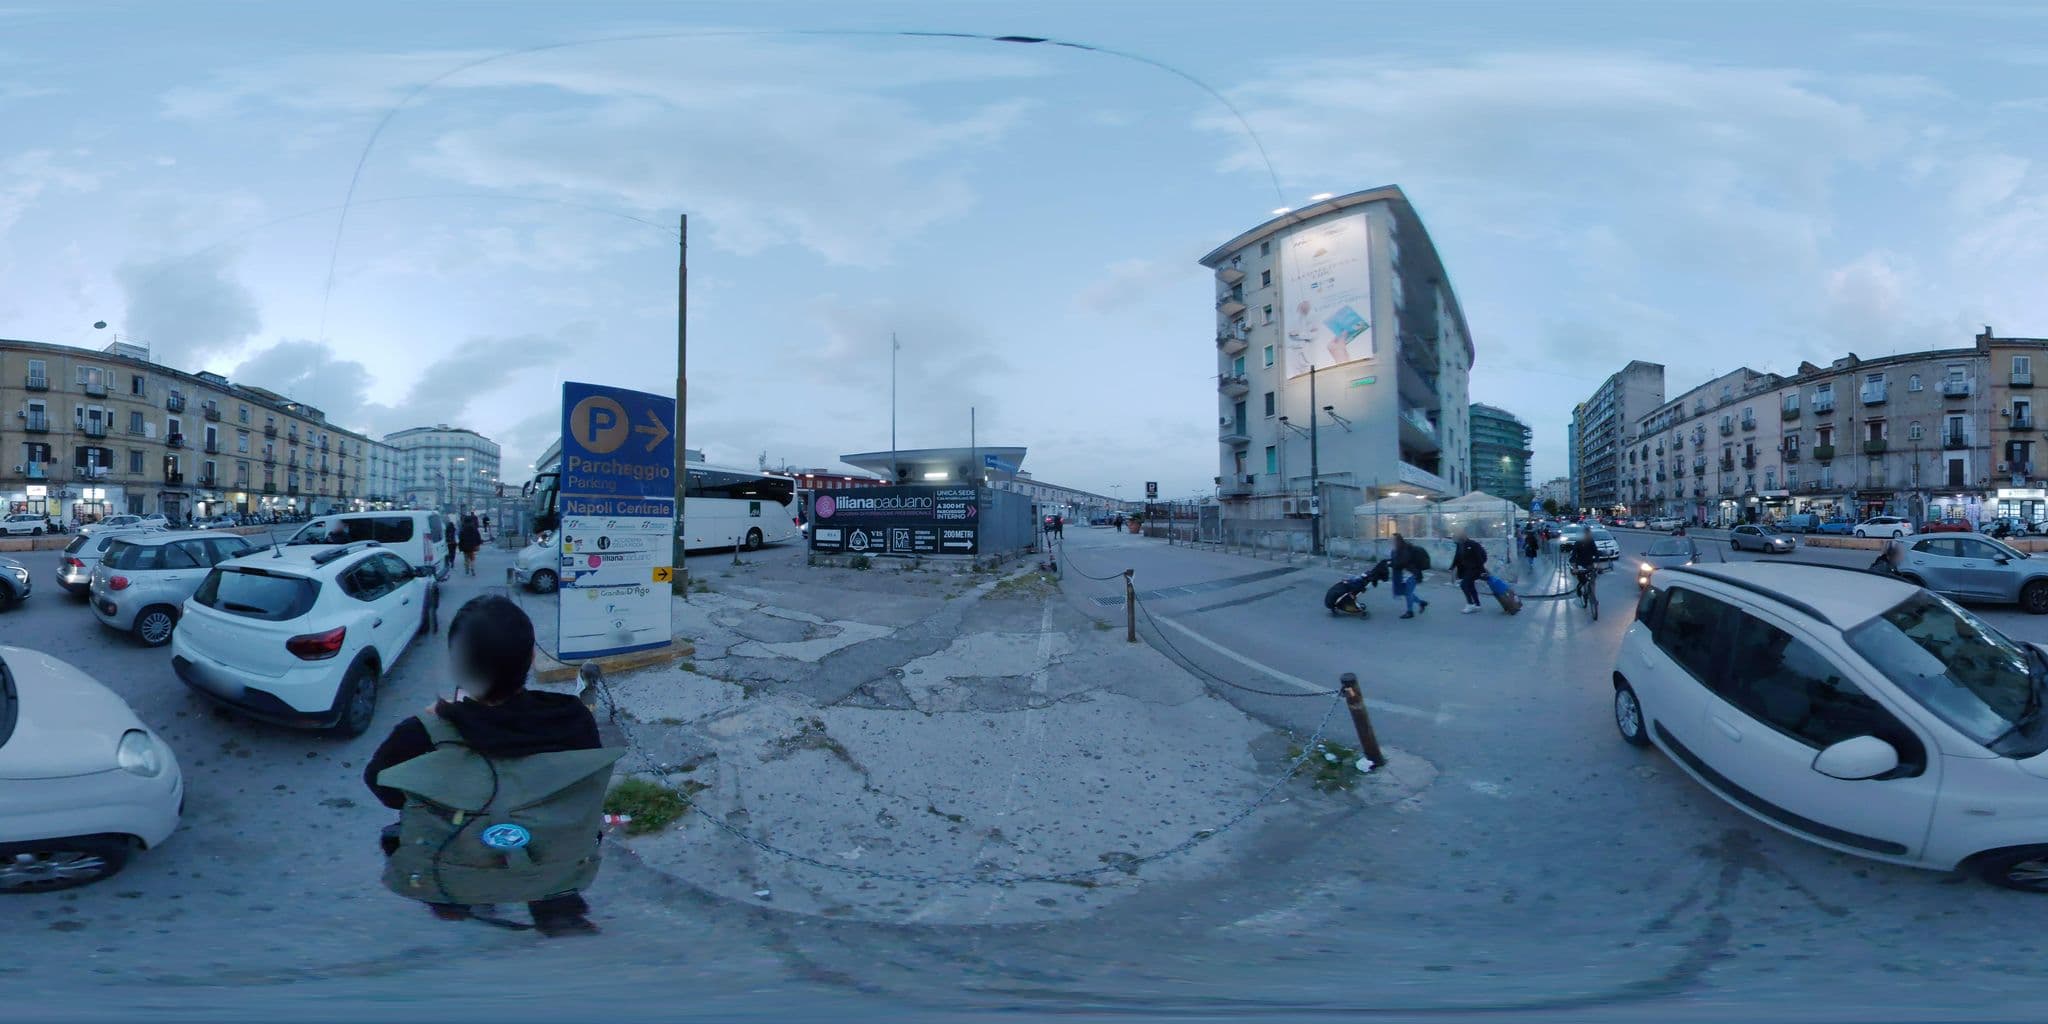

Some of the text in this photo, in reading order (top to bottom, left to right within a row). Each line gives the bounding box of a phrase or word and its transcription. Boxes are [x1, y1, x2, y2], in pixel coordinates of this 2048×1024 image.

[588, 406, 617, 443] P
[568, 475, 617, 493] Parking
[567, 500, 670, 516] Napoli Centrale
